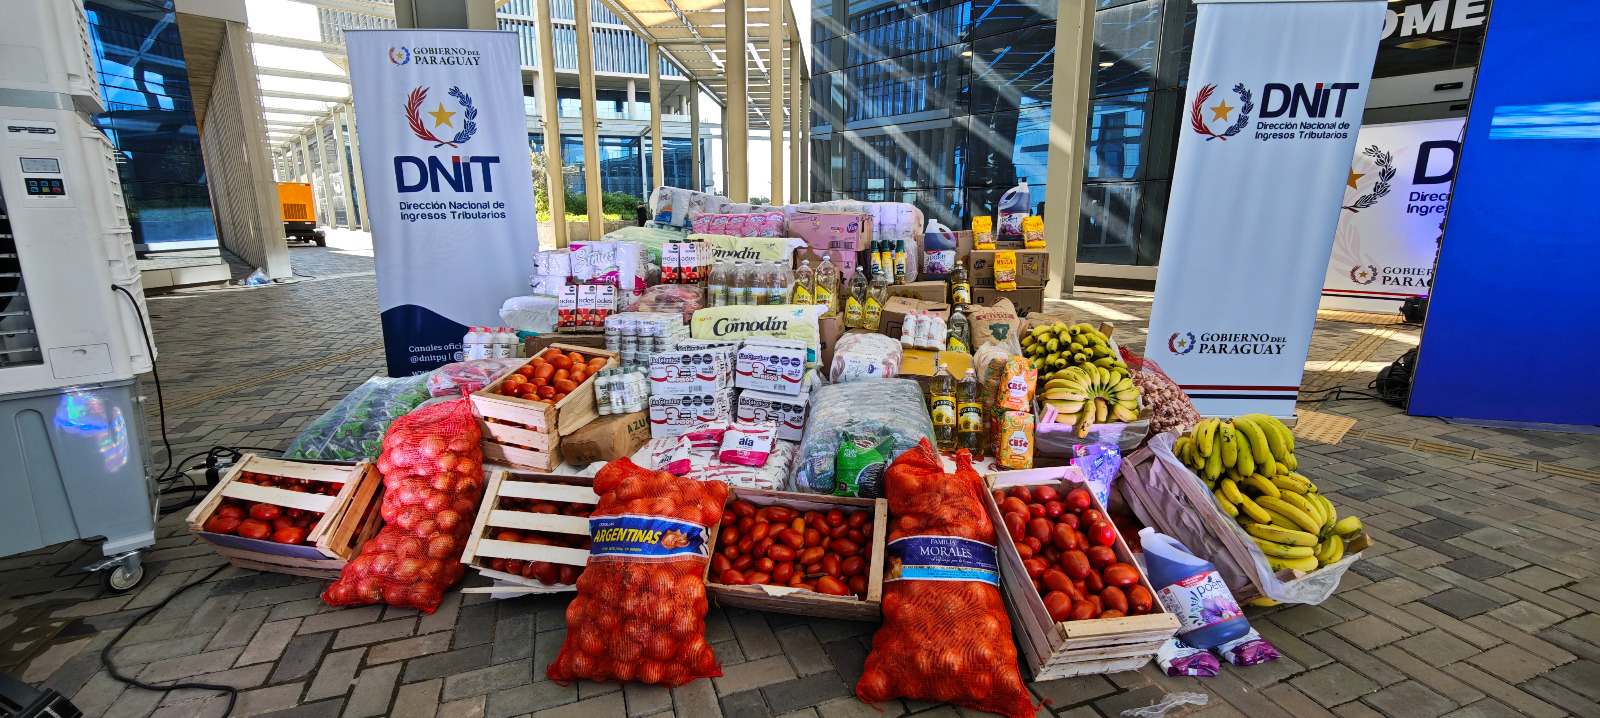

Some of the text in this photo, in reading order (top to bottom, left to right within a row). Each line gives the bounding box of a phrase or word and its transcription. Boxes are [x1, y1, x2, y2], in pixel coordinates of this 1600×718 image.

[413, 47, 467, 55] GOBIERNO
[414, 56, 480, 66] PARAGUAY
[1259, 83, 1359, 118] DNIT
[1256, 121, 1350, 130] Dirección Nacional de
[1255, 131, 1348, 141] Ingresos Tributarios
[394, 156, 500, 193] DNIT
[399, 200, 505, 210] Dirección Nacional de
[400, 211, 506, 222] Ingresos Tributarios
[713, 315, 788, 337] Comodín
[1200, 333, 1270, 342] GOBIERNO
[408, 344, 443, 353] Canales
[1198, 343, 1286, 354] PARAGUAY
[410, 354, 447, 363] @dnitpy
[593, 527, 663, 545] ARGENTINAS
[919, 545, 973, 558] MORALES
